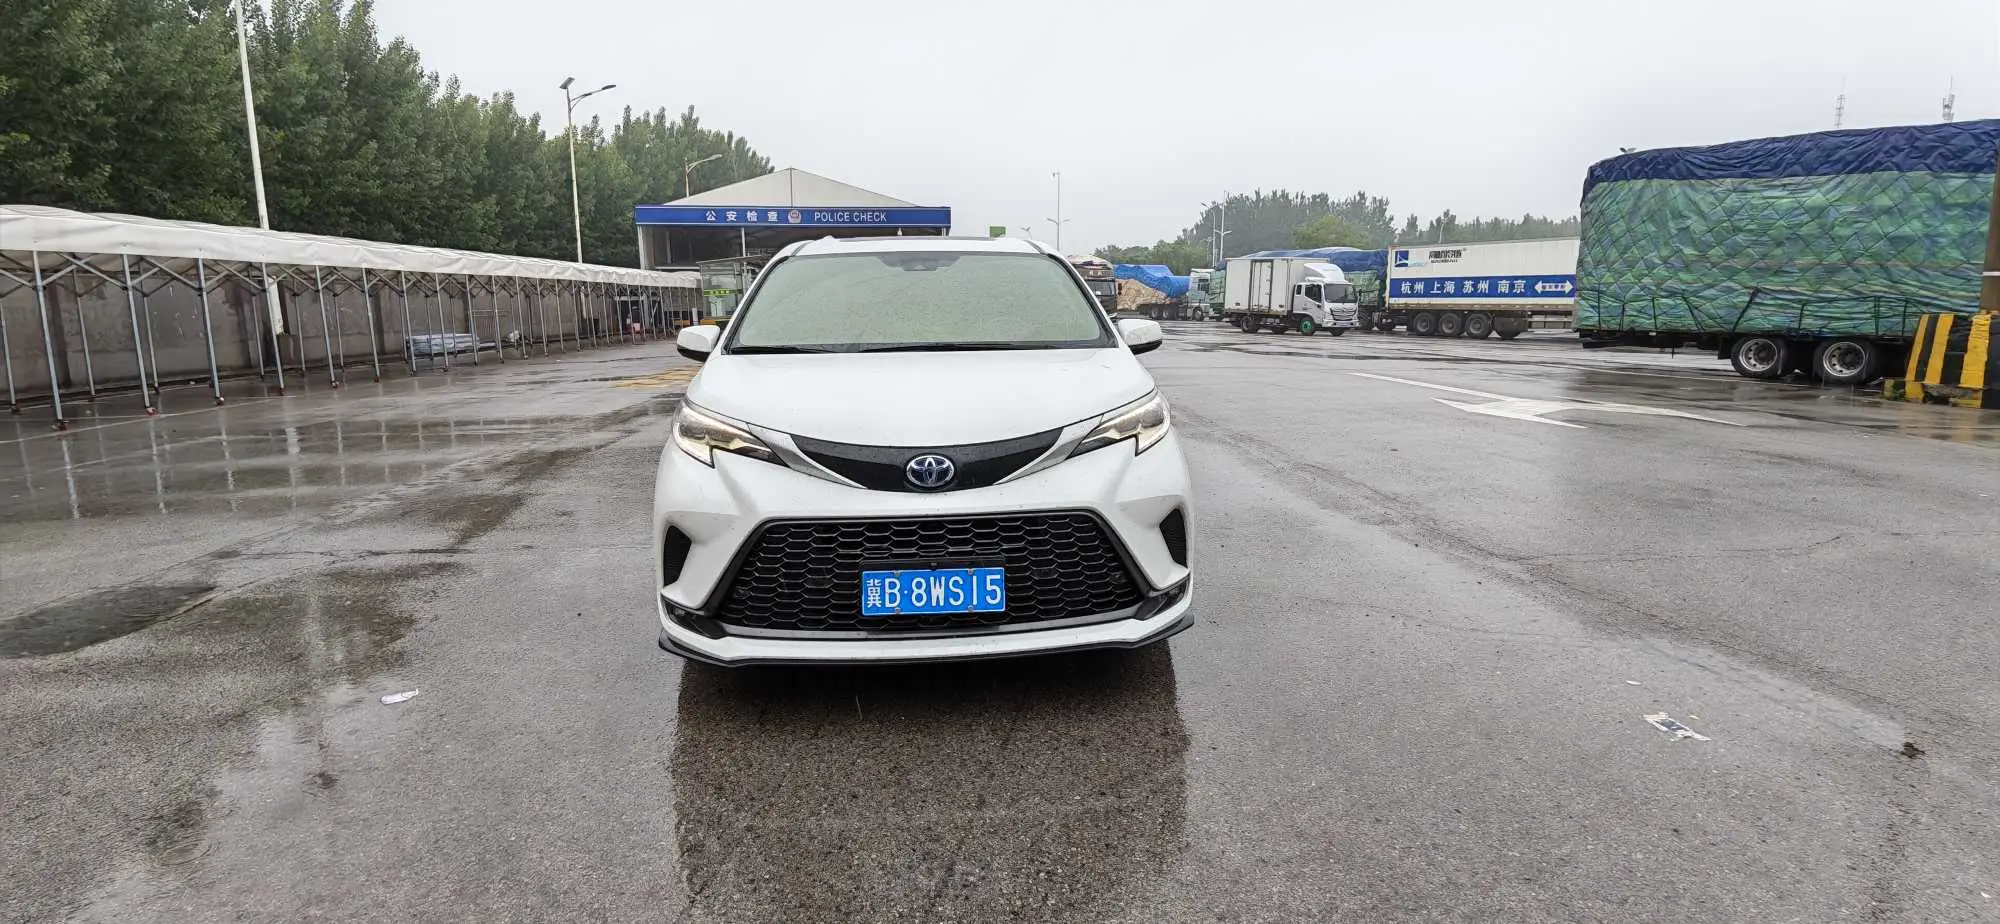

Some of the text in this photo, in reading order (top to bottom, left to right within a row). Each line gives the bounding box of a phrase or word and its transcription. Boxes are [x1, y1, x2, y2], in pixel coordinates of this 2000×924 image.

[705, 210, 778, 222] 公安检查
[814, 212, 887, 222] POLICE CHECK
[1400, 281, 1424, 294] 杭州
[1430, 280, 1455, 294] 上海
[1462, 280, 1490, 294] 苏州
[1497, 279, 1527, 293] 南京
